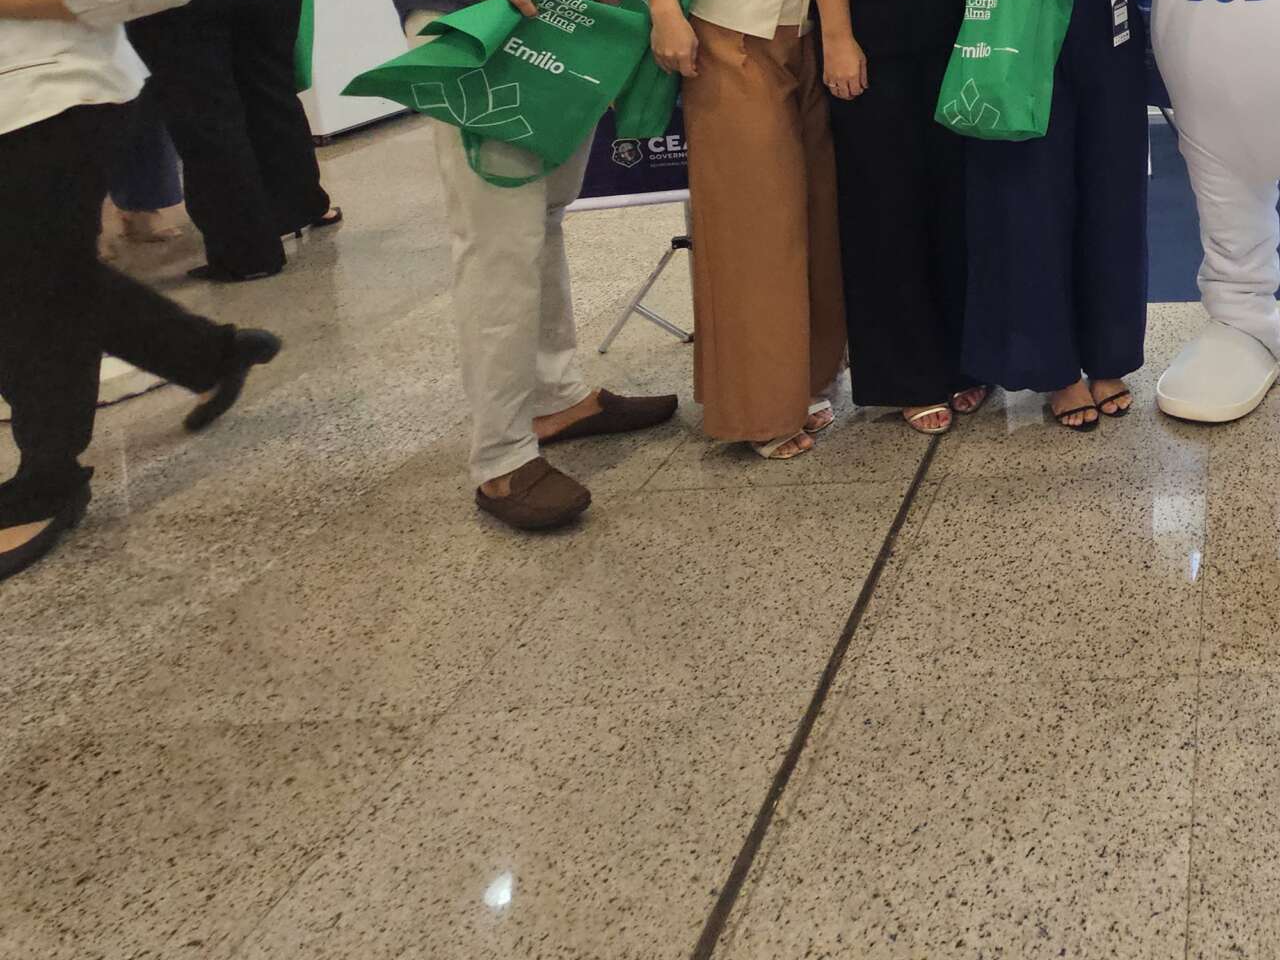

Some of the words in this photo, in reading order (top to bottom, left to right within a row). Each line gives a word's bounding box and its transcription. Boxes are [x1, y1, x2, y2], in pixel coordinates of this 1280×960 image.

[540, 11, 577, 32] Alma
[556, 5, 595, 26] Corpo
[503, 37, 565, 74] Emilio
[961, 42, 991, 58] milio
